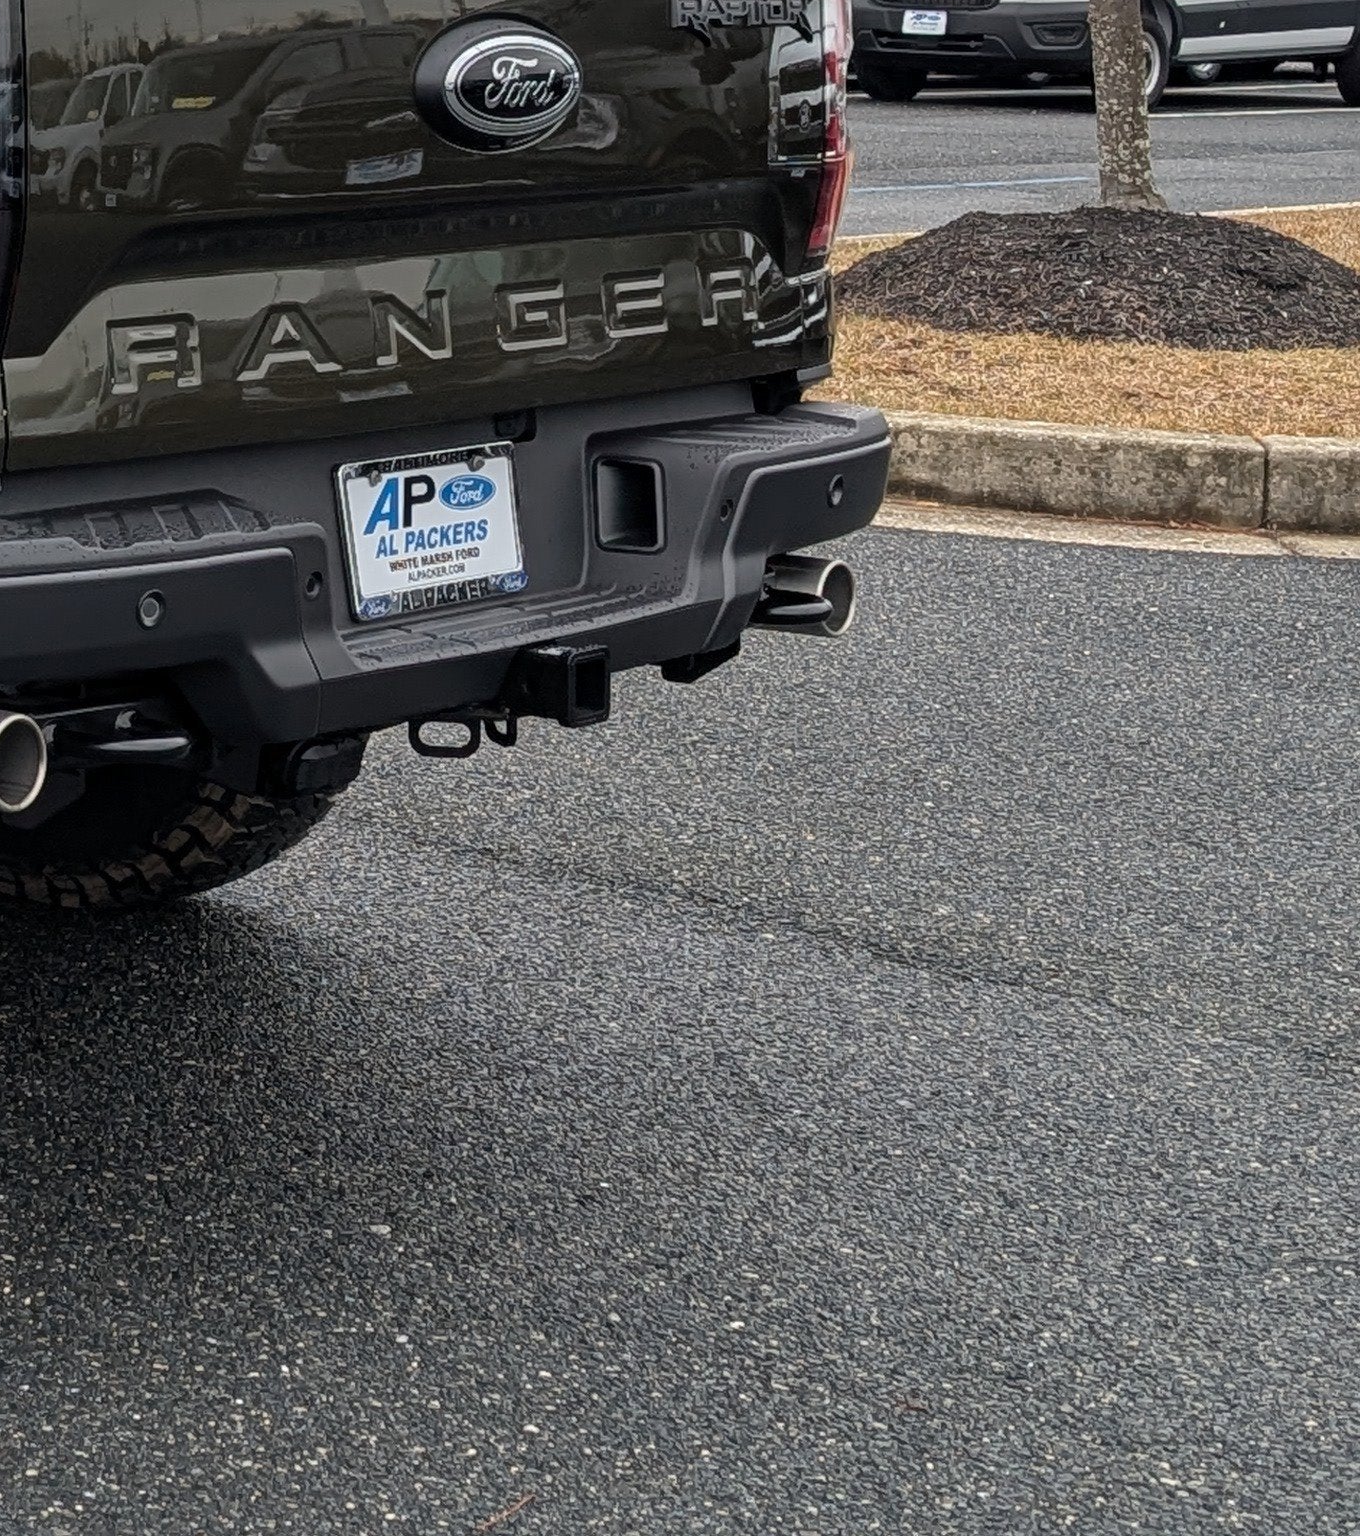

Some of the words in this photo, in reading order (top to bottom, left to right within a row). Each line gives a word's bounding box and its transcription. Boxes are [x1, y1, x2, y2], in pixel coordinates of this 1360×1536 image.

[484, 55, 561, 109] Ford
[104, 263, 758, 395] RANGER
[363, 475, 436, 535] AP
[449, 478, 487, 506] Ford
[375, 534, 399, 559] AL
[404, 519, 489, 554] PACKERS
[389, 557, 419, 573] WHITE
[421, 550, 454, 567] MARSH
[455, 547, 480, 563] FORD
[408, 563, 466, 583] ALPACKER.COM
